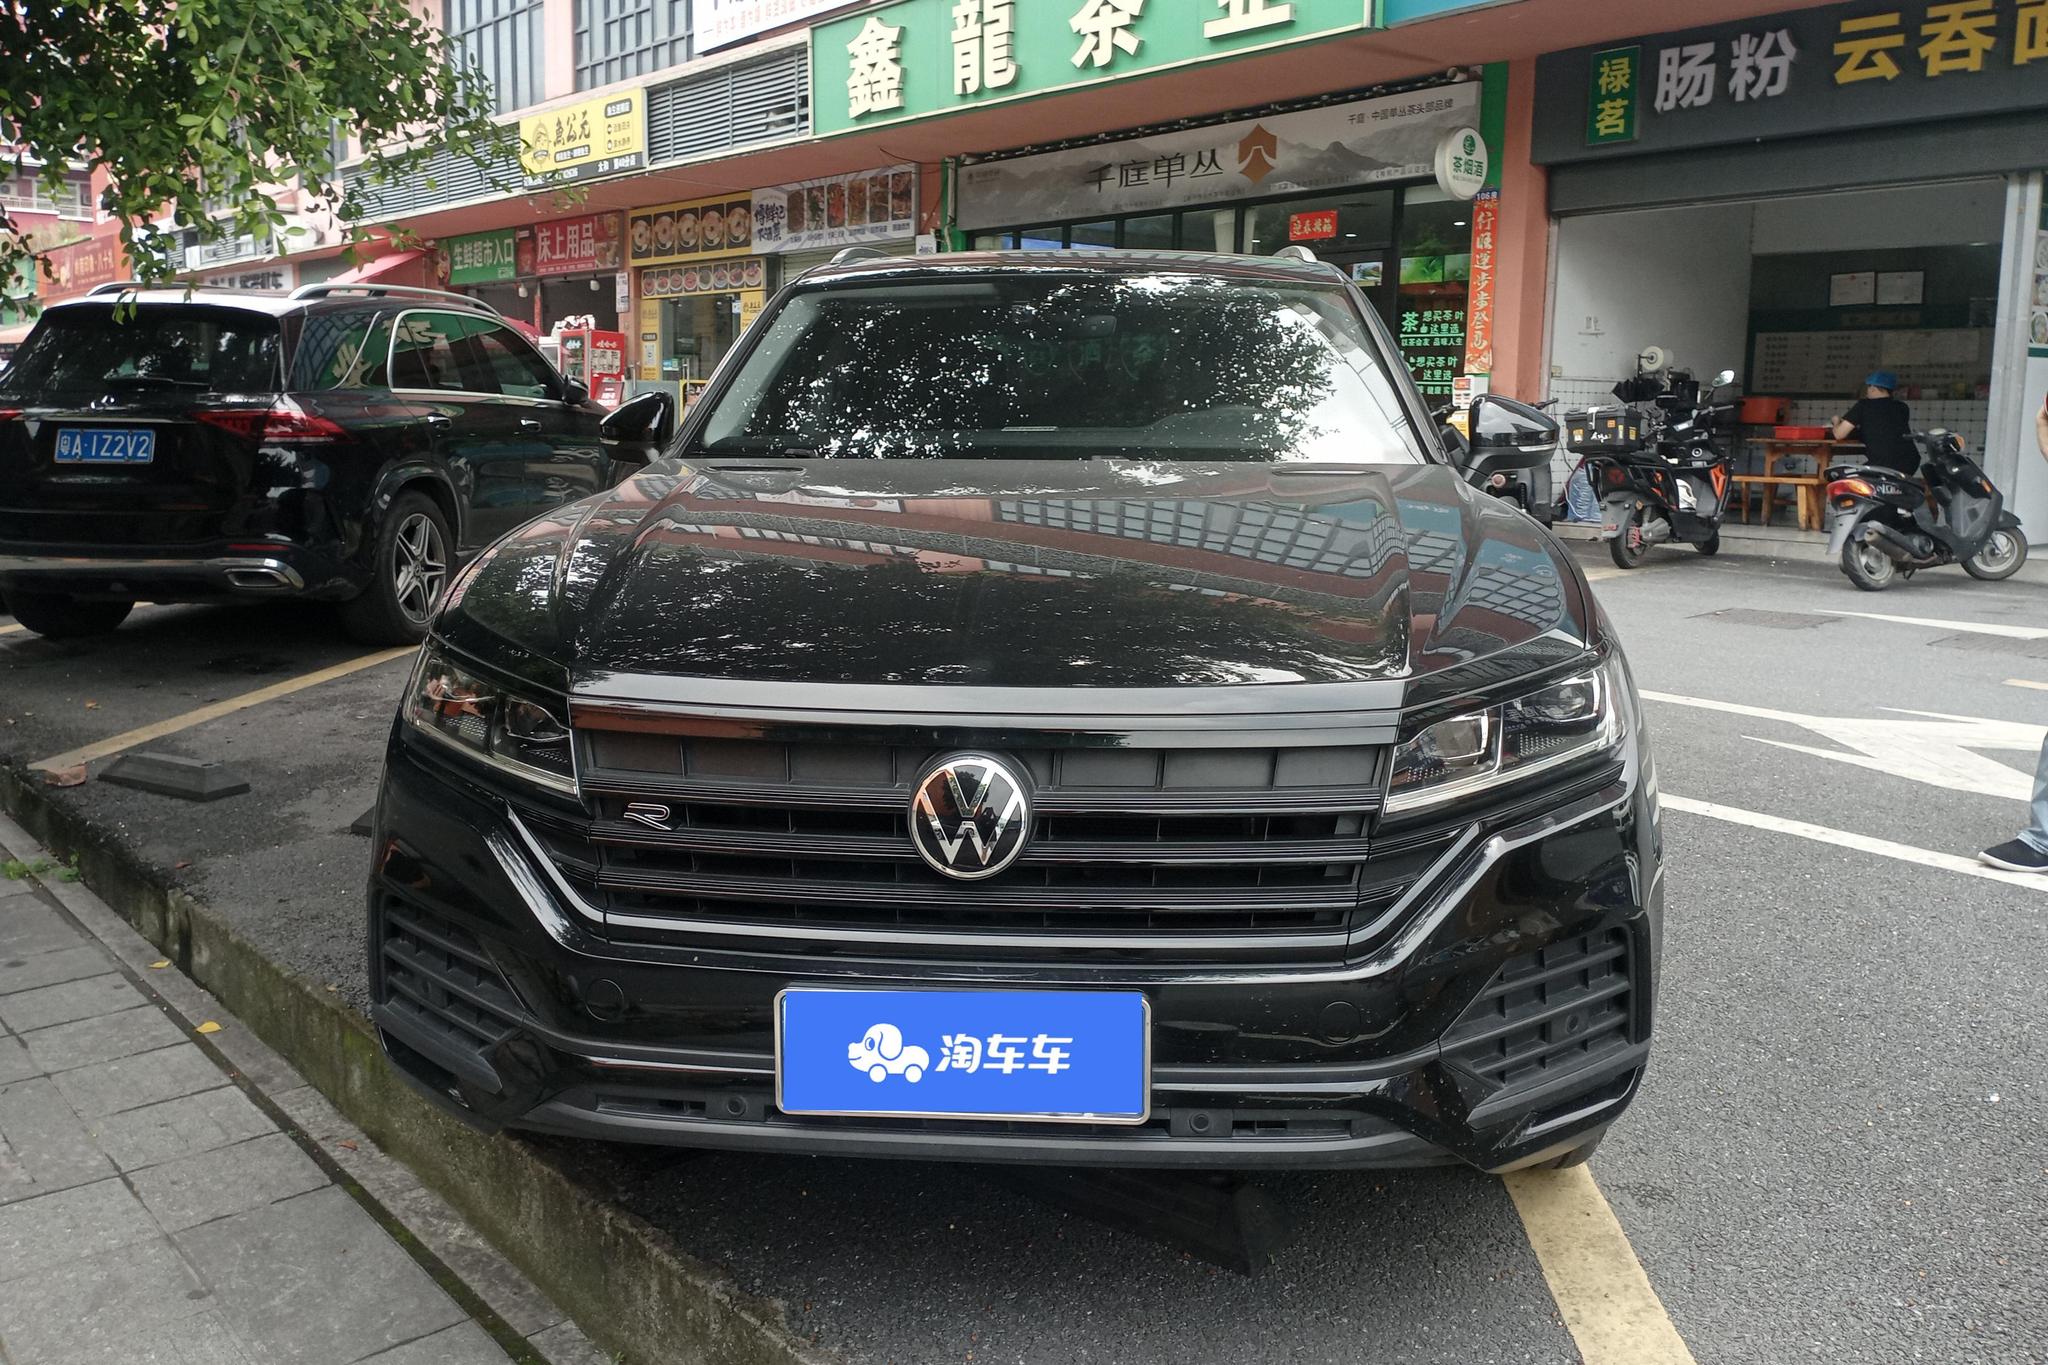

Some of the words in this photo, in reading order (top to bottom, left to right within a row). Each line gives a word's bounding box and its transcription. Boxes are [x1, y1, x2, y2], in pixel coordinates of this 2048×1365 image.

[1654, 29, 1798, 113] 肠粉
[1595, 58, 1632, 136] 禄茗
[1085, 148, 1224, 194] 千庭单丛
[453, 238, 514, 271] 生鲜超市入口
[536, 222, 595, 262] 床上用品
[1402, 311, 1419, 332] 茶
